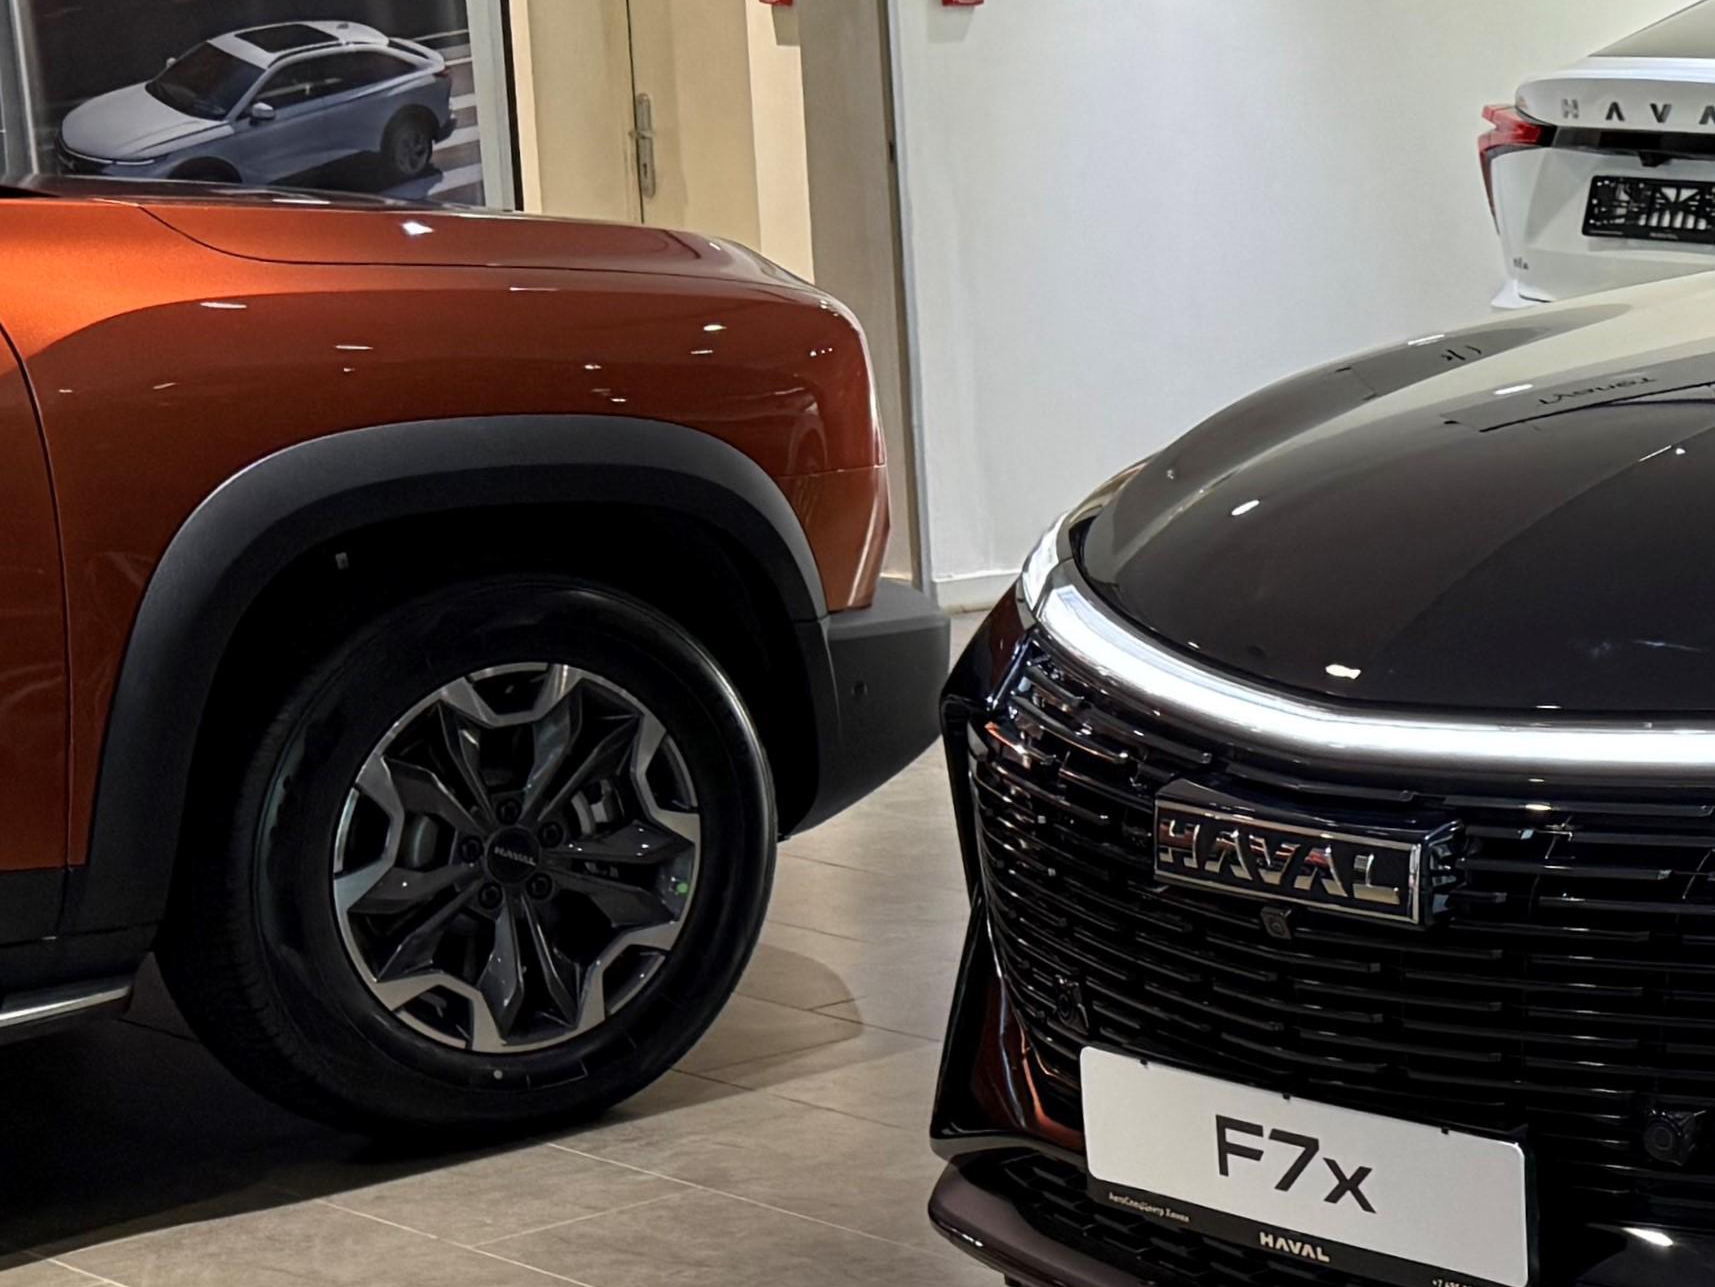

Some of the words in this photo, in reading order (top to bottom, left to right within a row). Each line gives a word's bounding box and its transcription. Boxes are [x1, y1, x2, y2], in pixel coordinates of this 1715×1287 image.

[1158, 817, 1401, 906] HAVAL
[1214, 1114, 1378, 1214] F7x
[1259, 1231, 1331, 1264] HAVAL
